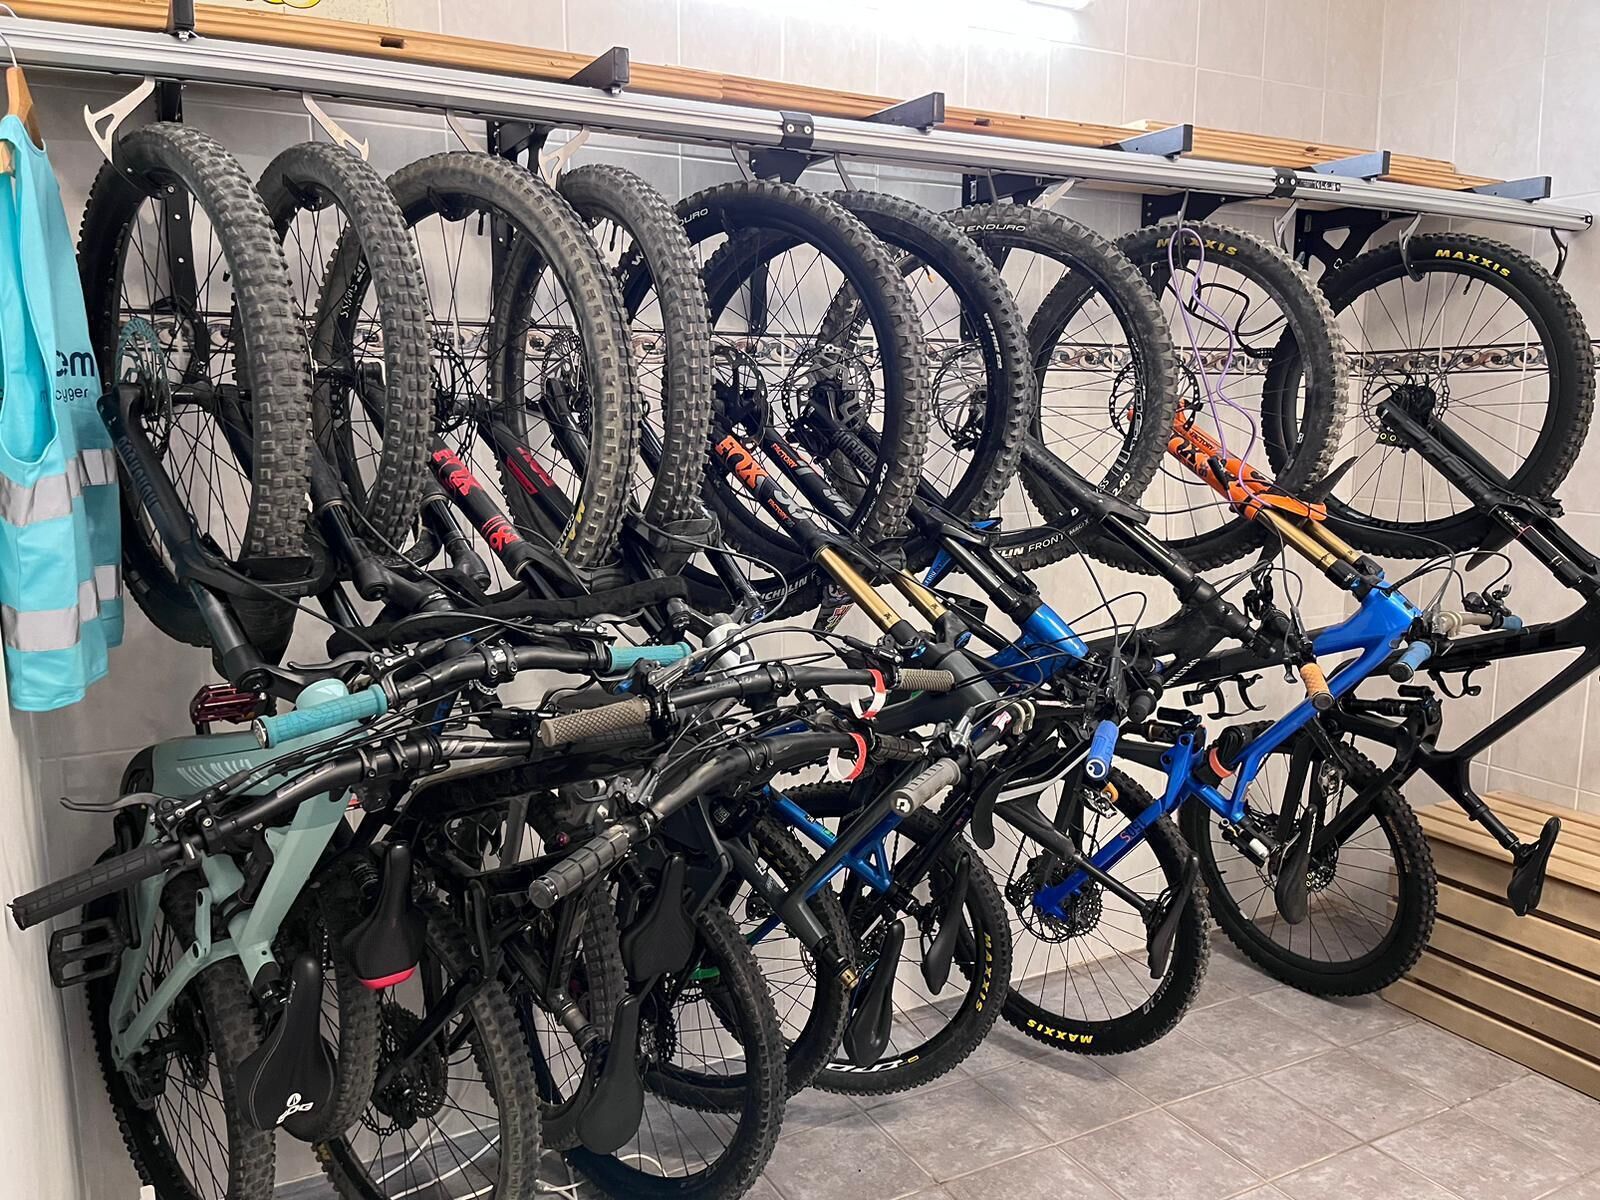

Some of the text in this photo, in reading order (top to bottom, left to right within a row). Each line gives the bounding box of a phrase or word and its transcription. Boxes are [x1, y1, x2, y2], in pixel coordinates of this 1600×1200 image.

[966, 223, 1026, 232] ENDURO
[1435, 249, 1511, 277] MAXXIS
[715, 434, 769, 490] FOX
[770, 442, 799, 470] FACTORY
[874, 462, 889, 497] 2.40
[1111, 470, 1132, 497] 2.40
[1028, 532, 1065, 553] FRONT
[975, 931, 993, 1012] MAXXIS
[1026, 1019, 1094, 1044] MAXXIS
